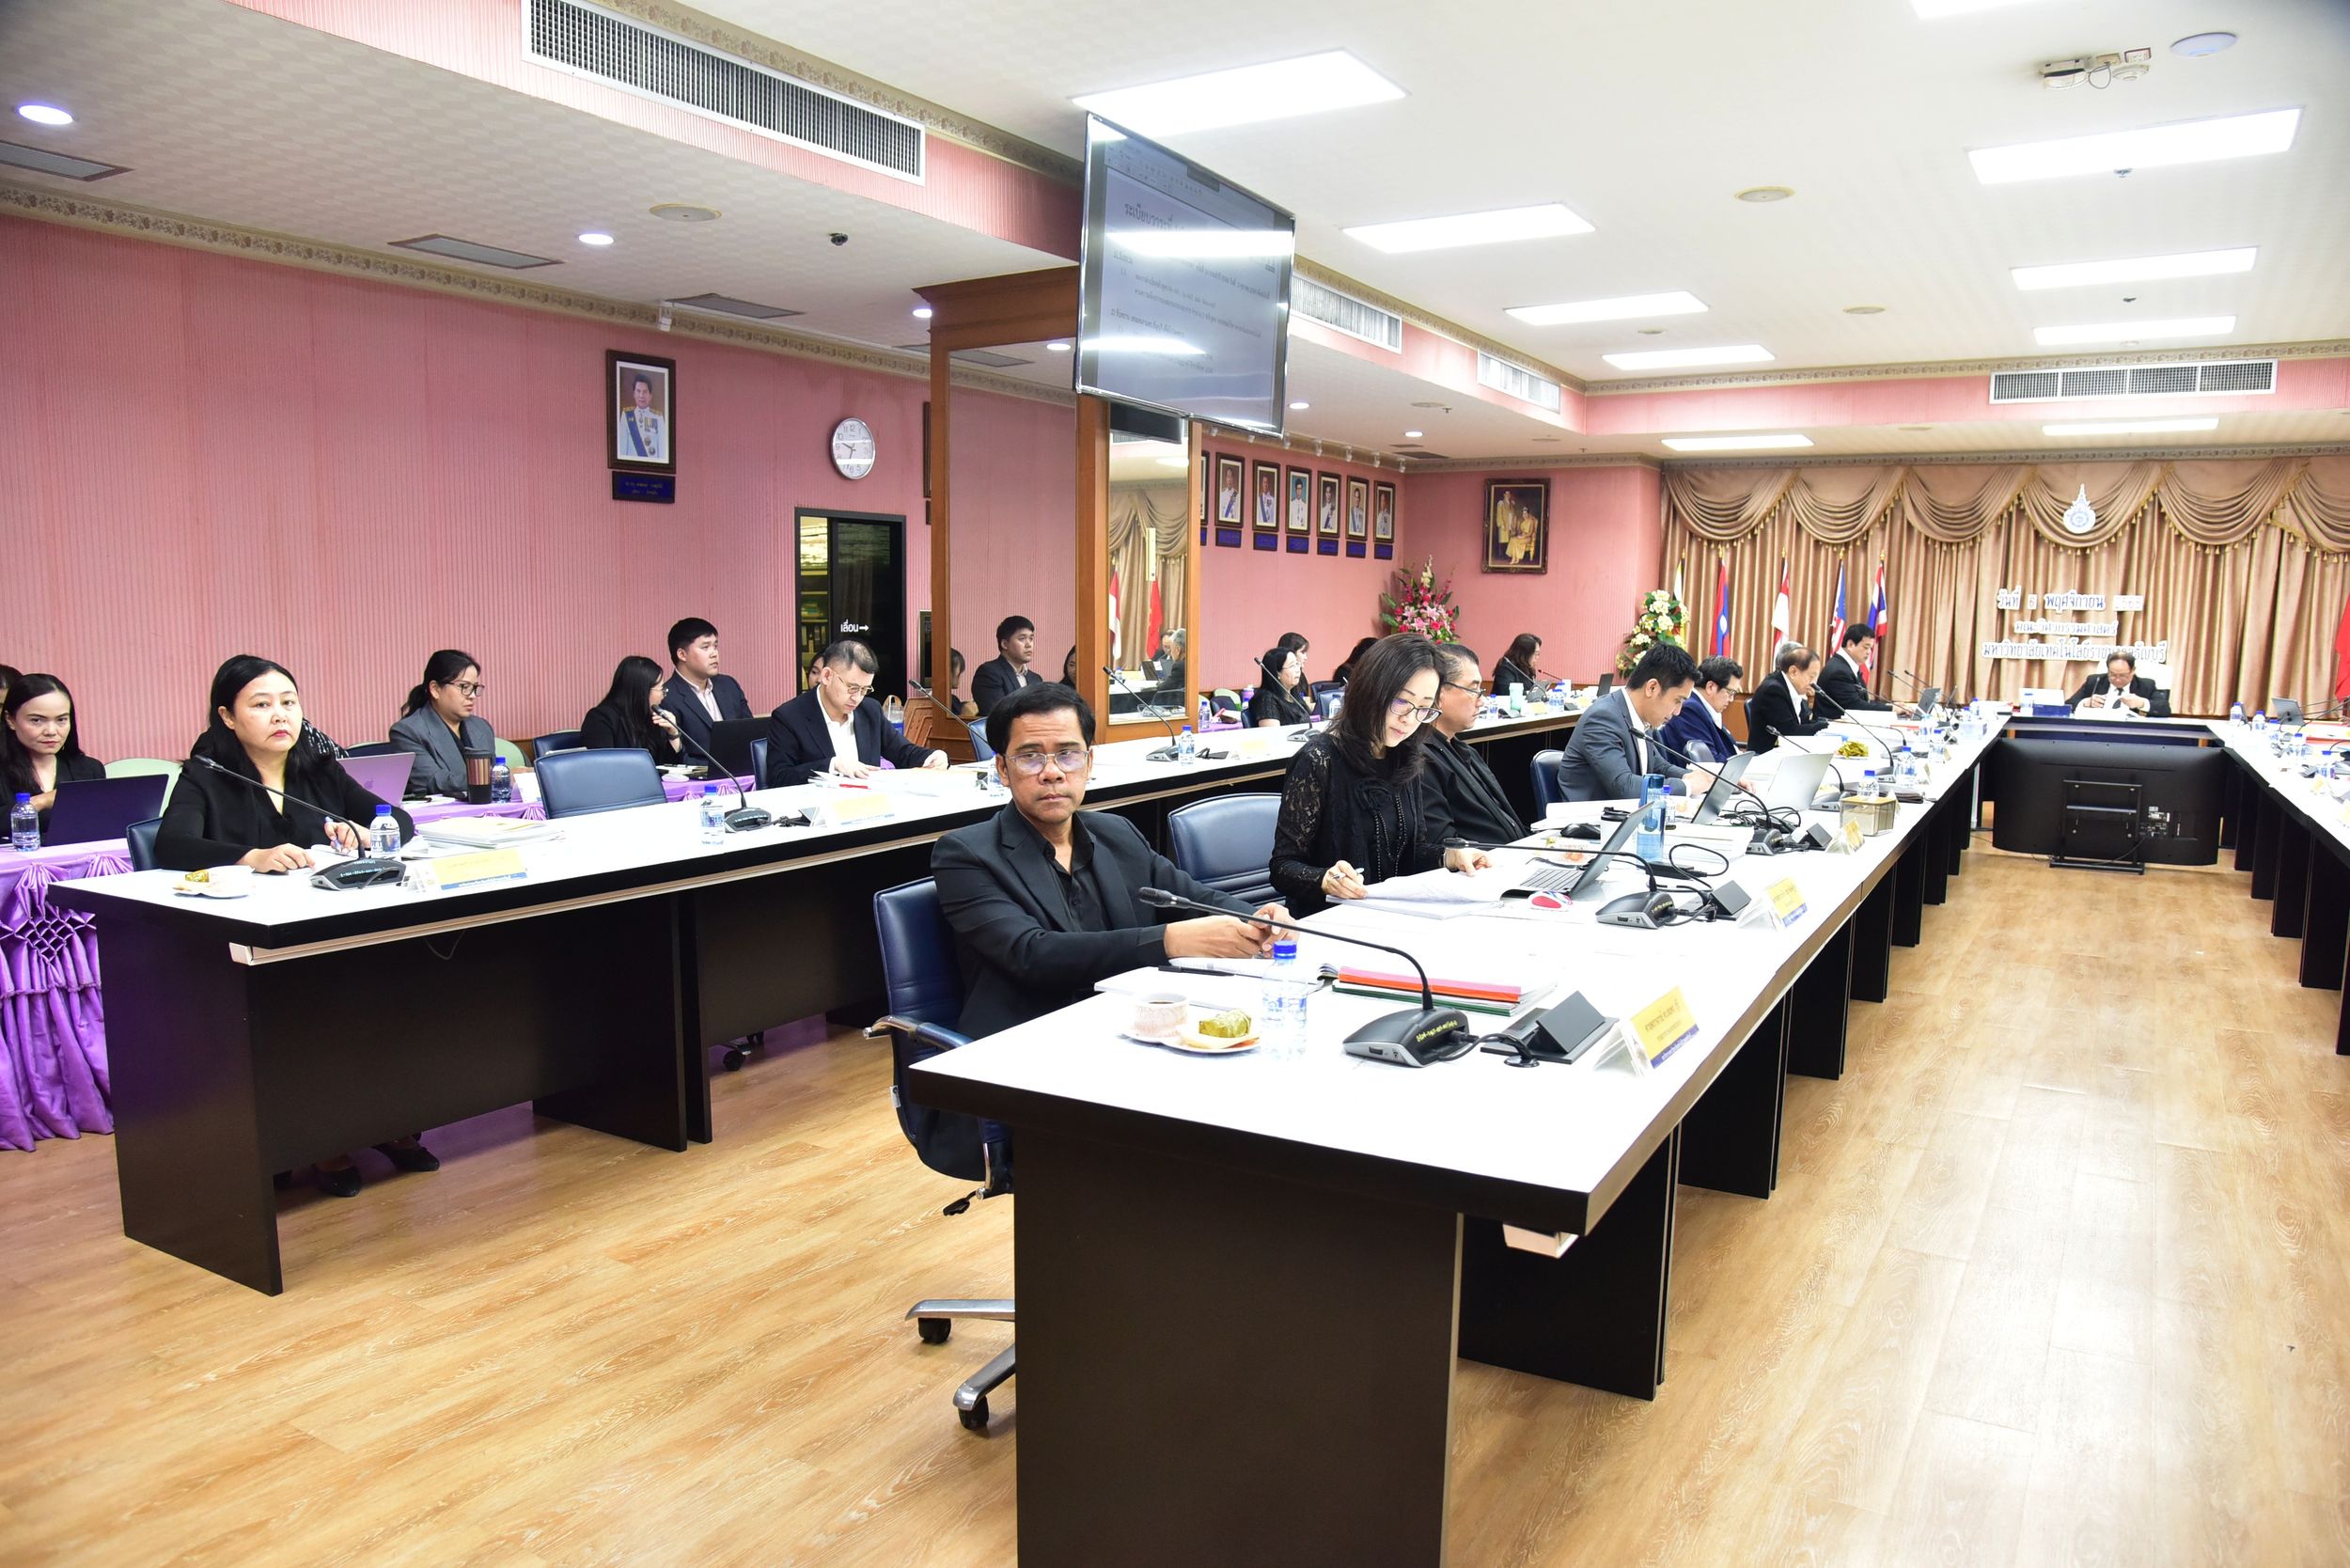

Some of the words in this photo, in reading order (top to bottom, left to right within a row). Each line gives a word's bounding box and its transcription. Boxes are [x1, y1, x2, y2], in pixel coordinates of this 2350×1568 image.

[1998, 588, 2020, 607] วันที่
[2046, 591, 2104, 610] พฤศจิกายน
[840, 619, 859, 633] เลื่อน
[2015, 620, 2118, 635] คณะวิศวกรรมศาสตร์
